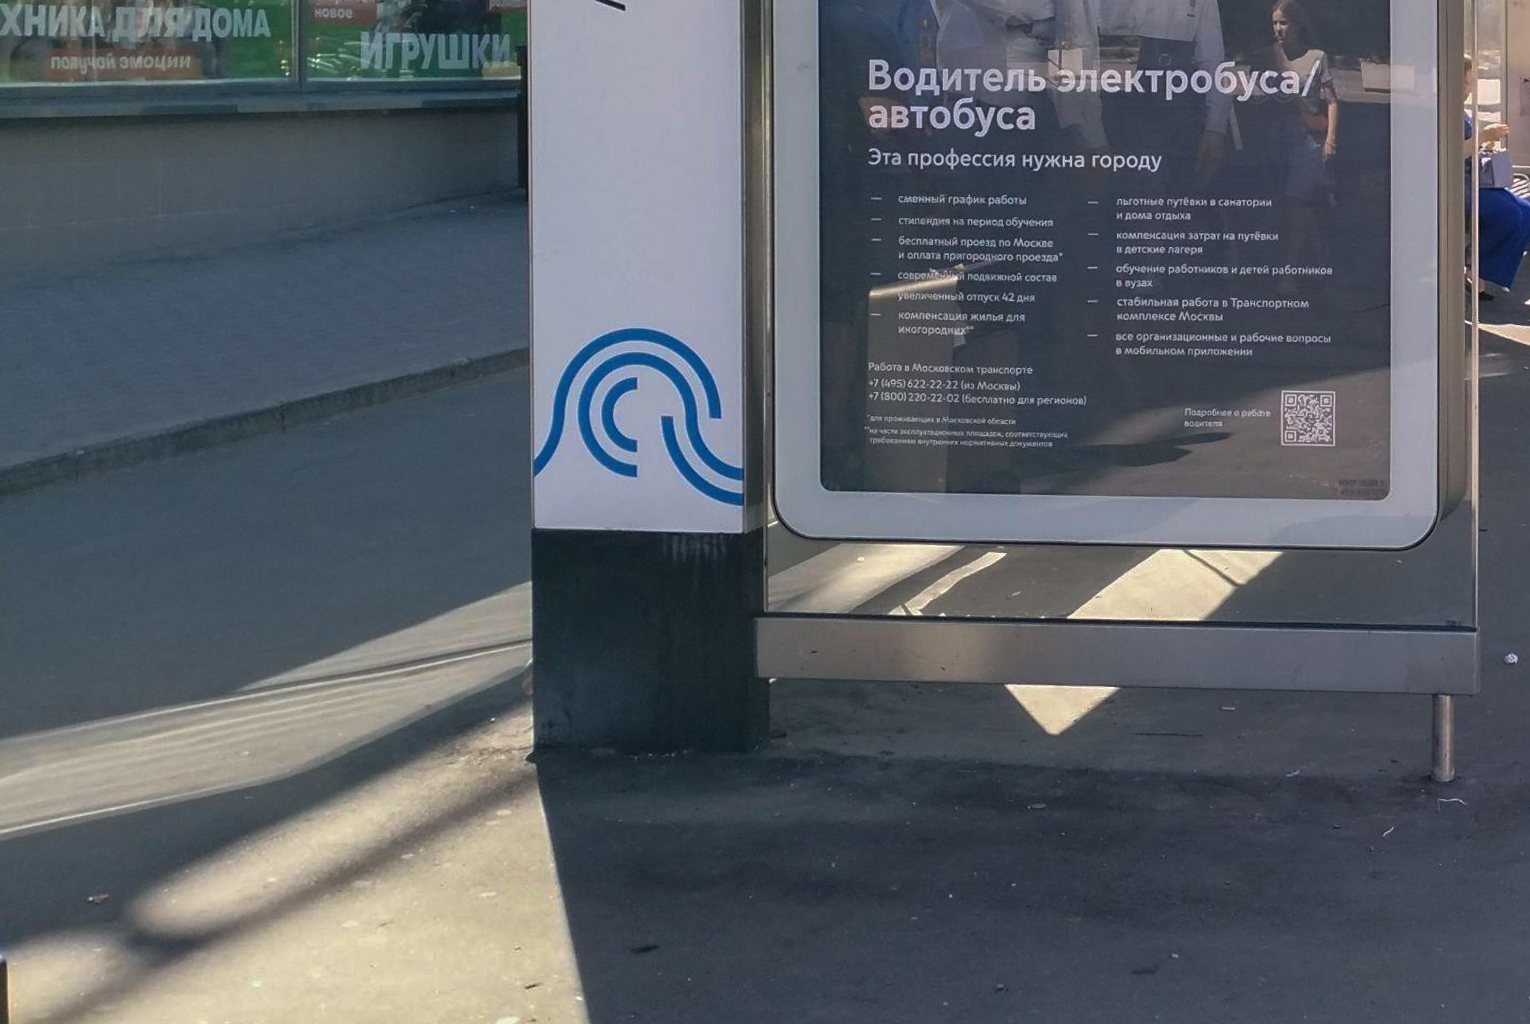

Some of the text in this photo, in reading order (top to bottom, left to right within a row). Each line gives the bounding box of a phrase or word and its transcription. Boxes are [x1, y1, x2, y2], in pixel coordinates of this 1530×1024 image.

[314, 7, 354, 19] новое
[0, 3, 272, 43] ХНИКА ДЛЯ ДОМА
[360, 31, 511, 70] ИГРУШКИ
[51, 54, 191, 75] получай эмоции
[868, 58, 1321, 102] Водитель электробуса/
[868, 97, 1036, 138] автобуса
[867, 147, 1163, 173] Эта профессия нужна городу
[898, 194, 1027, 207] сменный график работы
[1116, 198, 1164, 207] льготные
[1167, 196, 1208, 209] путёвки
[1218, 199, 1272, 209] санатории
[898, 216, 1054, 229] стипендия на период обучения
[1116, 212, 1191, 222] и дома отдыха
[898, 235, 1054, 249] бесплатный проезд по Москве
[1116, 231, 1279, 243] компенсация затрат на путёвки
[907, 251, 942, 260] оплата
[943, 252, 1014, 263] пригородного
[1124, 245, 1166, 255] детские
[1167, 246, 1203, 256] лагеря
[1116, 263, 1333, 276] обучение работников и детей работников
[897, 272, 1057, 283] современный подвижной состав
[1116, 279, 1153, 289] в вузах
[897, 292, 1036, 304] увеличенный отпуск 42 дня
[1117, 297, 1310, 309] стабильная работа в Транспортном
[898, 312, 1026, 323] компенсация жилья для
[1117, 312, 1224, 322] комплексе Москвы
[1115, 332, 1332, 345] все организационные и рабочие вопросы
[1115, 346, 1253, 358] в мобильном приложении
[868, 362, 902, 372] Работа
[911, 363, 974, 374] Московском
[976, 365, 1033, 375] транспорте
[868, 378, 1021, 392] +7 (495) 622-22-22 (из Москвы)
[868, 391, 1087, 406] +7 (800) 220-22-02 (бесплатно для регионов)
